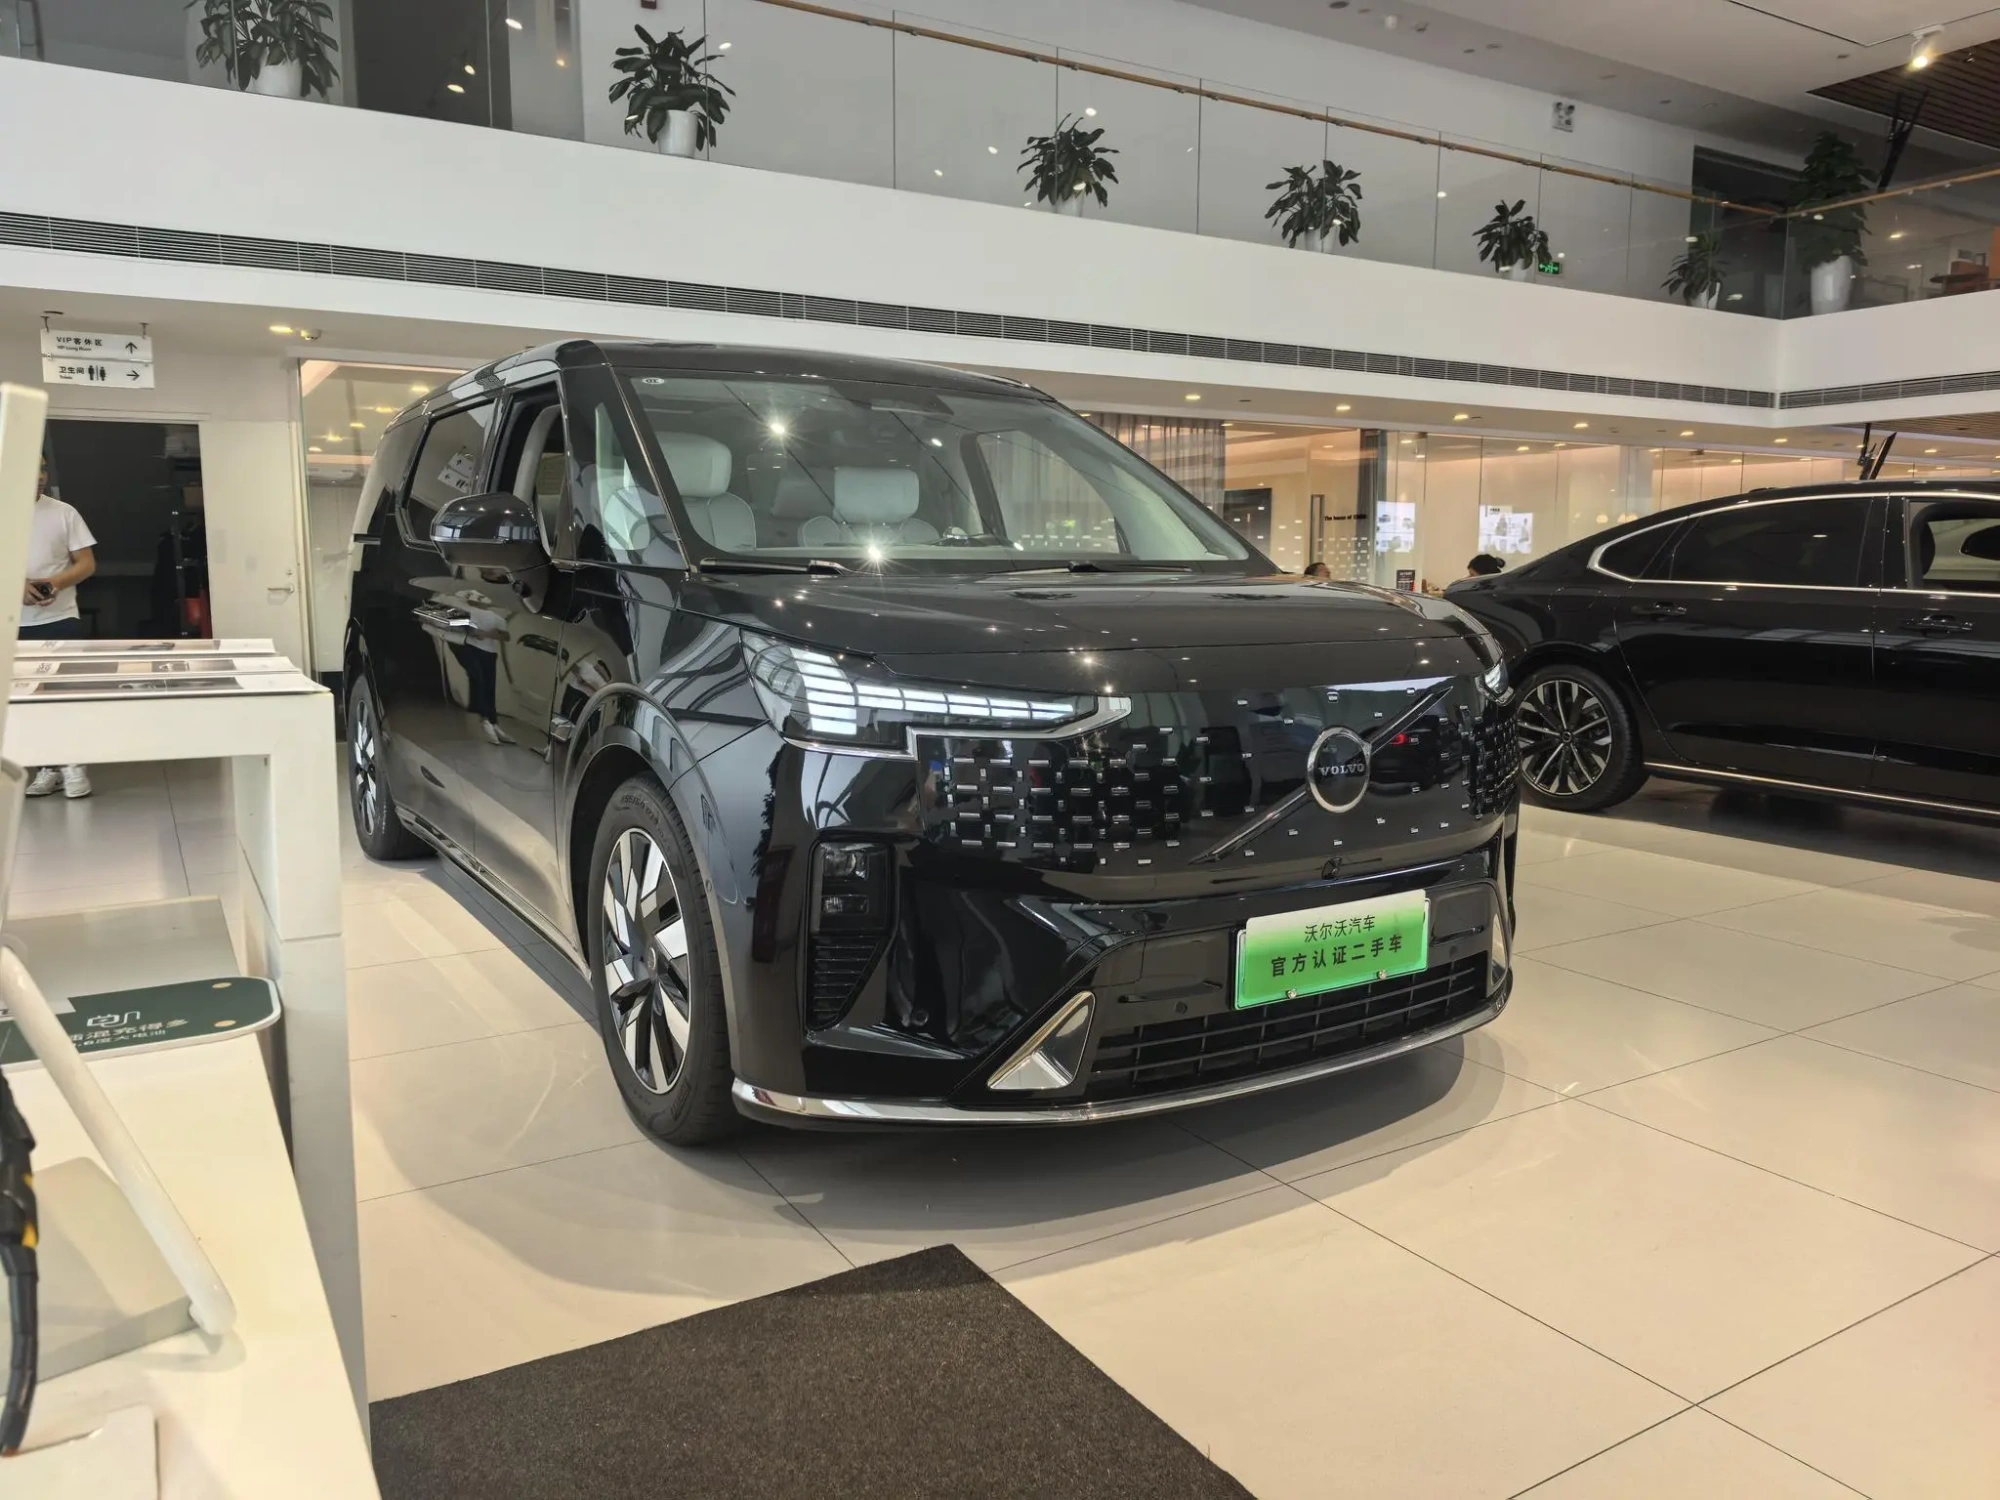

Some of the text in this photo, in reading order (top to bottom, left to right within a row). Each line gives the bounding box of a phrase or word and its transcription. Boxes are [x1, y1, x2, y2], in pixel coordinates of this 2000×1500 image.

[58, 366, 85, 374] 卫生间
[1318, 763, 1366, 777] VOLVO
[1304, 915, 1376, 943] 沃尔沃汽车
[1271, 934, 1403, 978] 官方认证二手车
